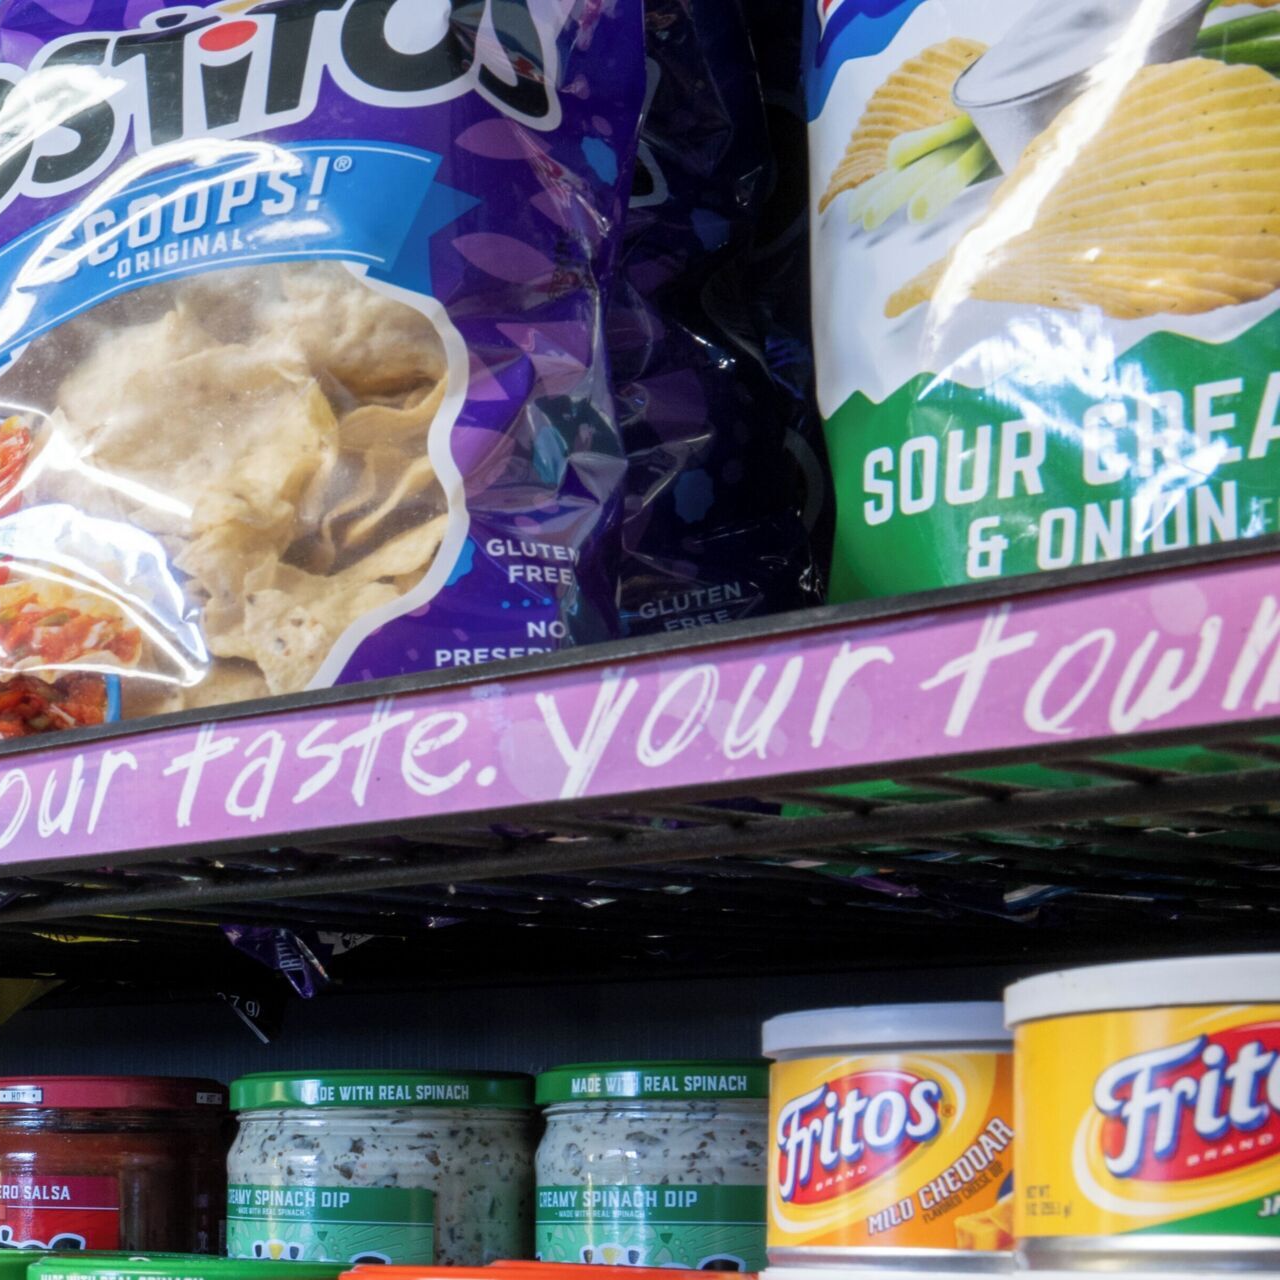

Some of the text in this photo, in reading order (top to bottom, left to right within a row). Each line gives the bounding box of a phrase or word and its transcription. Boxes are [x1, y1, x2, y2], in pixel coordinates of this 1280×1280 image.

[862, 418, 1047, 526] SOUR
[966, 480, 1243, 578] & ONION
[487, 538, 581, 563] GLUTEN
[507, 564, 573, 586] FREE
[526, 619, 567, 639] NO
[164, 695, 498, 829] taste.
[536, 640, 895, 800] your
[340, 1084, 470, 1101] WITH REAL SPINACH
[571, 1075, 747, 1093] MADE WITH REAL SPINACH
[777, 1078, 944, 1203] Fritos
[1186, 1131, 1274, 1168] BRAND
[816, 1164, 868, 1192] BRAND
[867, 1197, 915, 1237] MILD
[918, 1115, 1015, 1208] CHEDDAR
[24, 1185, 71, 1201] SALSA
[255, 1190, 350, 1207] SPINACH DIP
[582, 1190, 698, 1209] SPINACH DIP
